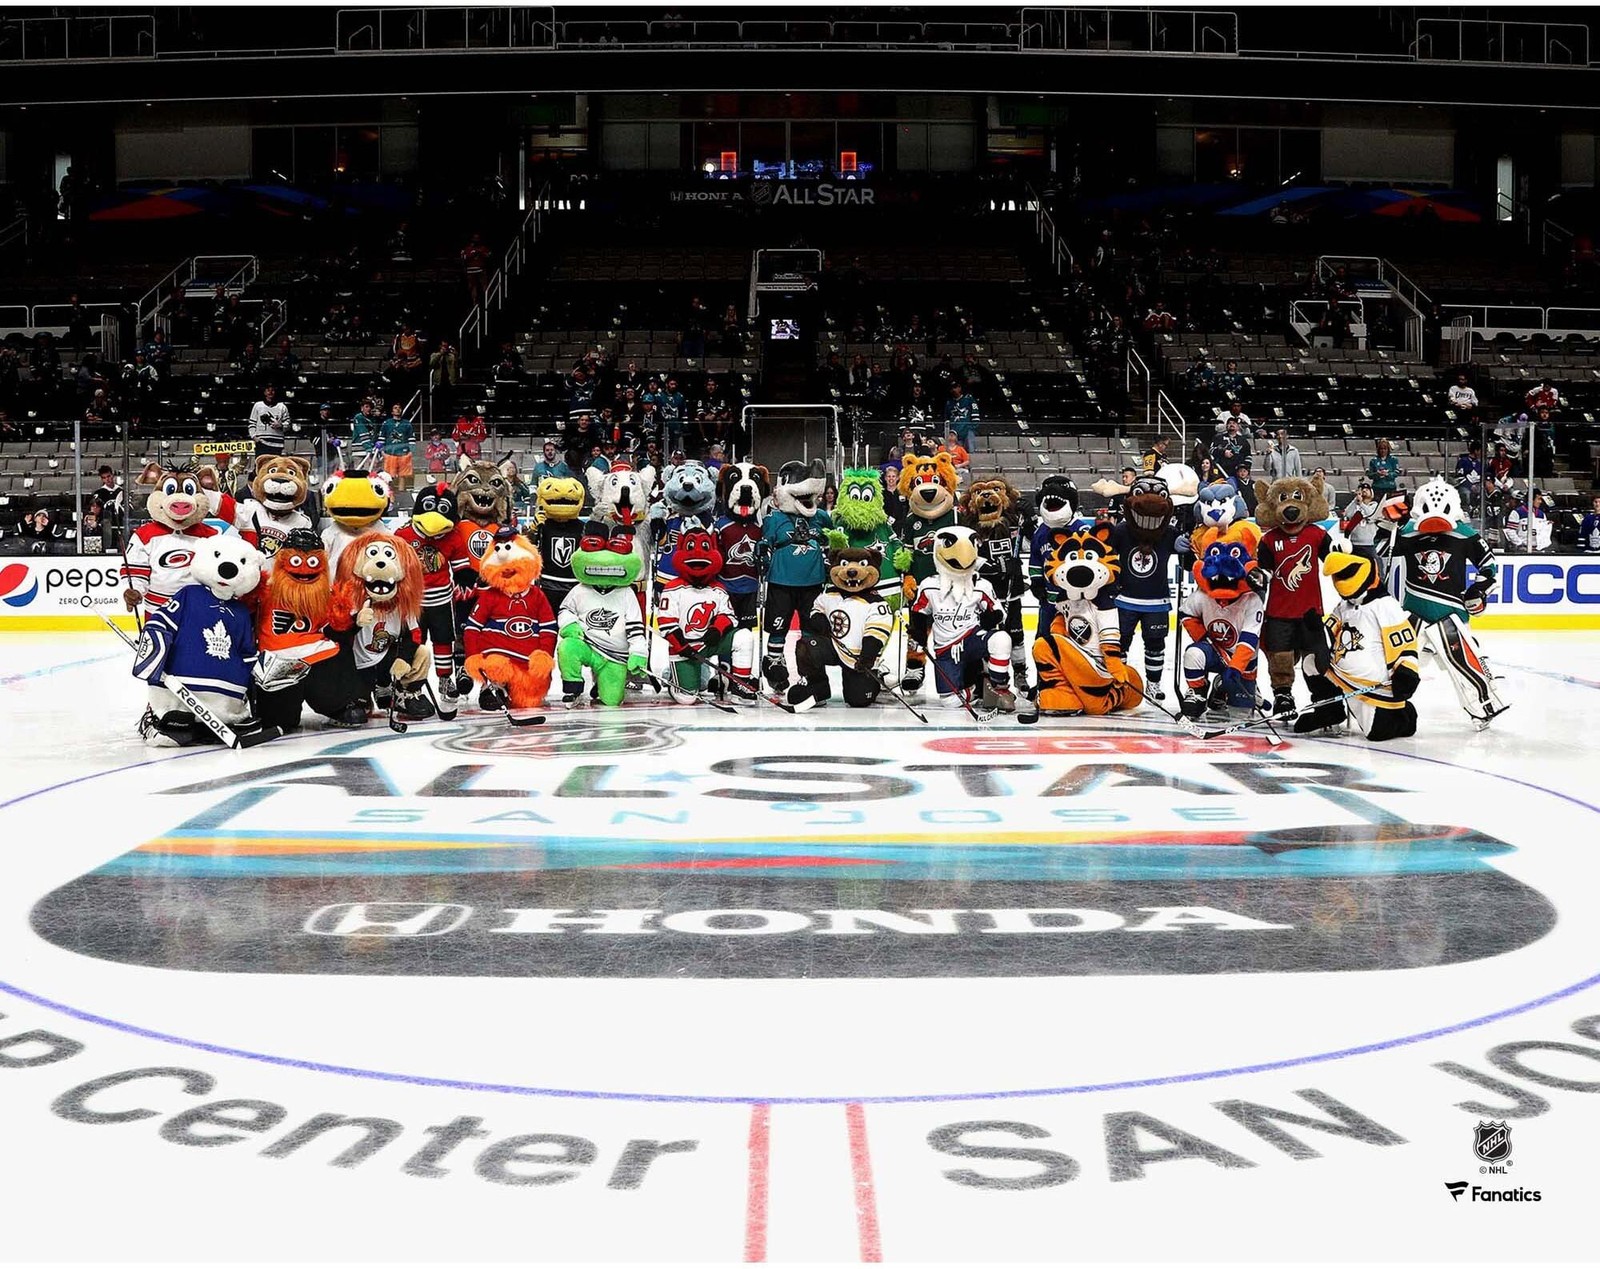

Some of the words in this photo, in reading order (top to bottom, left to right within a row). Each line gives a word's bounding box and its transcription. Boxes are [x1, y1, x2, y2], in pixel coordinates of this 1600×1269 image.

[203, 442, 246, 453] CHANCE!
[46, 568, 119, 594] peps
[1389, 627, 1415, 648] 00
[176, 686, 229, 738] Reebok
[150, 757, 678, 798] ALL
[700, 755, 1420, 802] STAR
[348, 809, 690, 825] SAN
[805, 807, 1249, 824] JOSE
[488, 905, 1294, 935] HONDA
[51, 1066, 699, 1190] Center
[926, 1087, 1409, 1191] SAN
